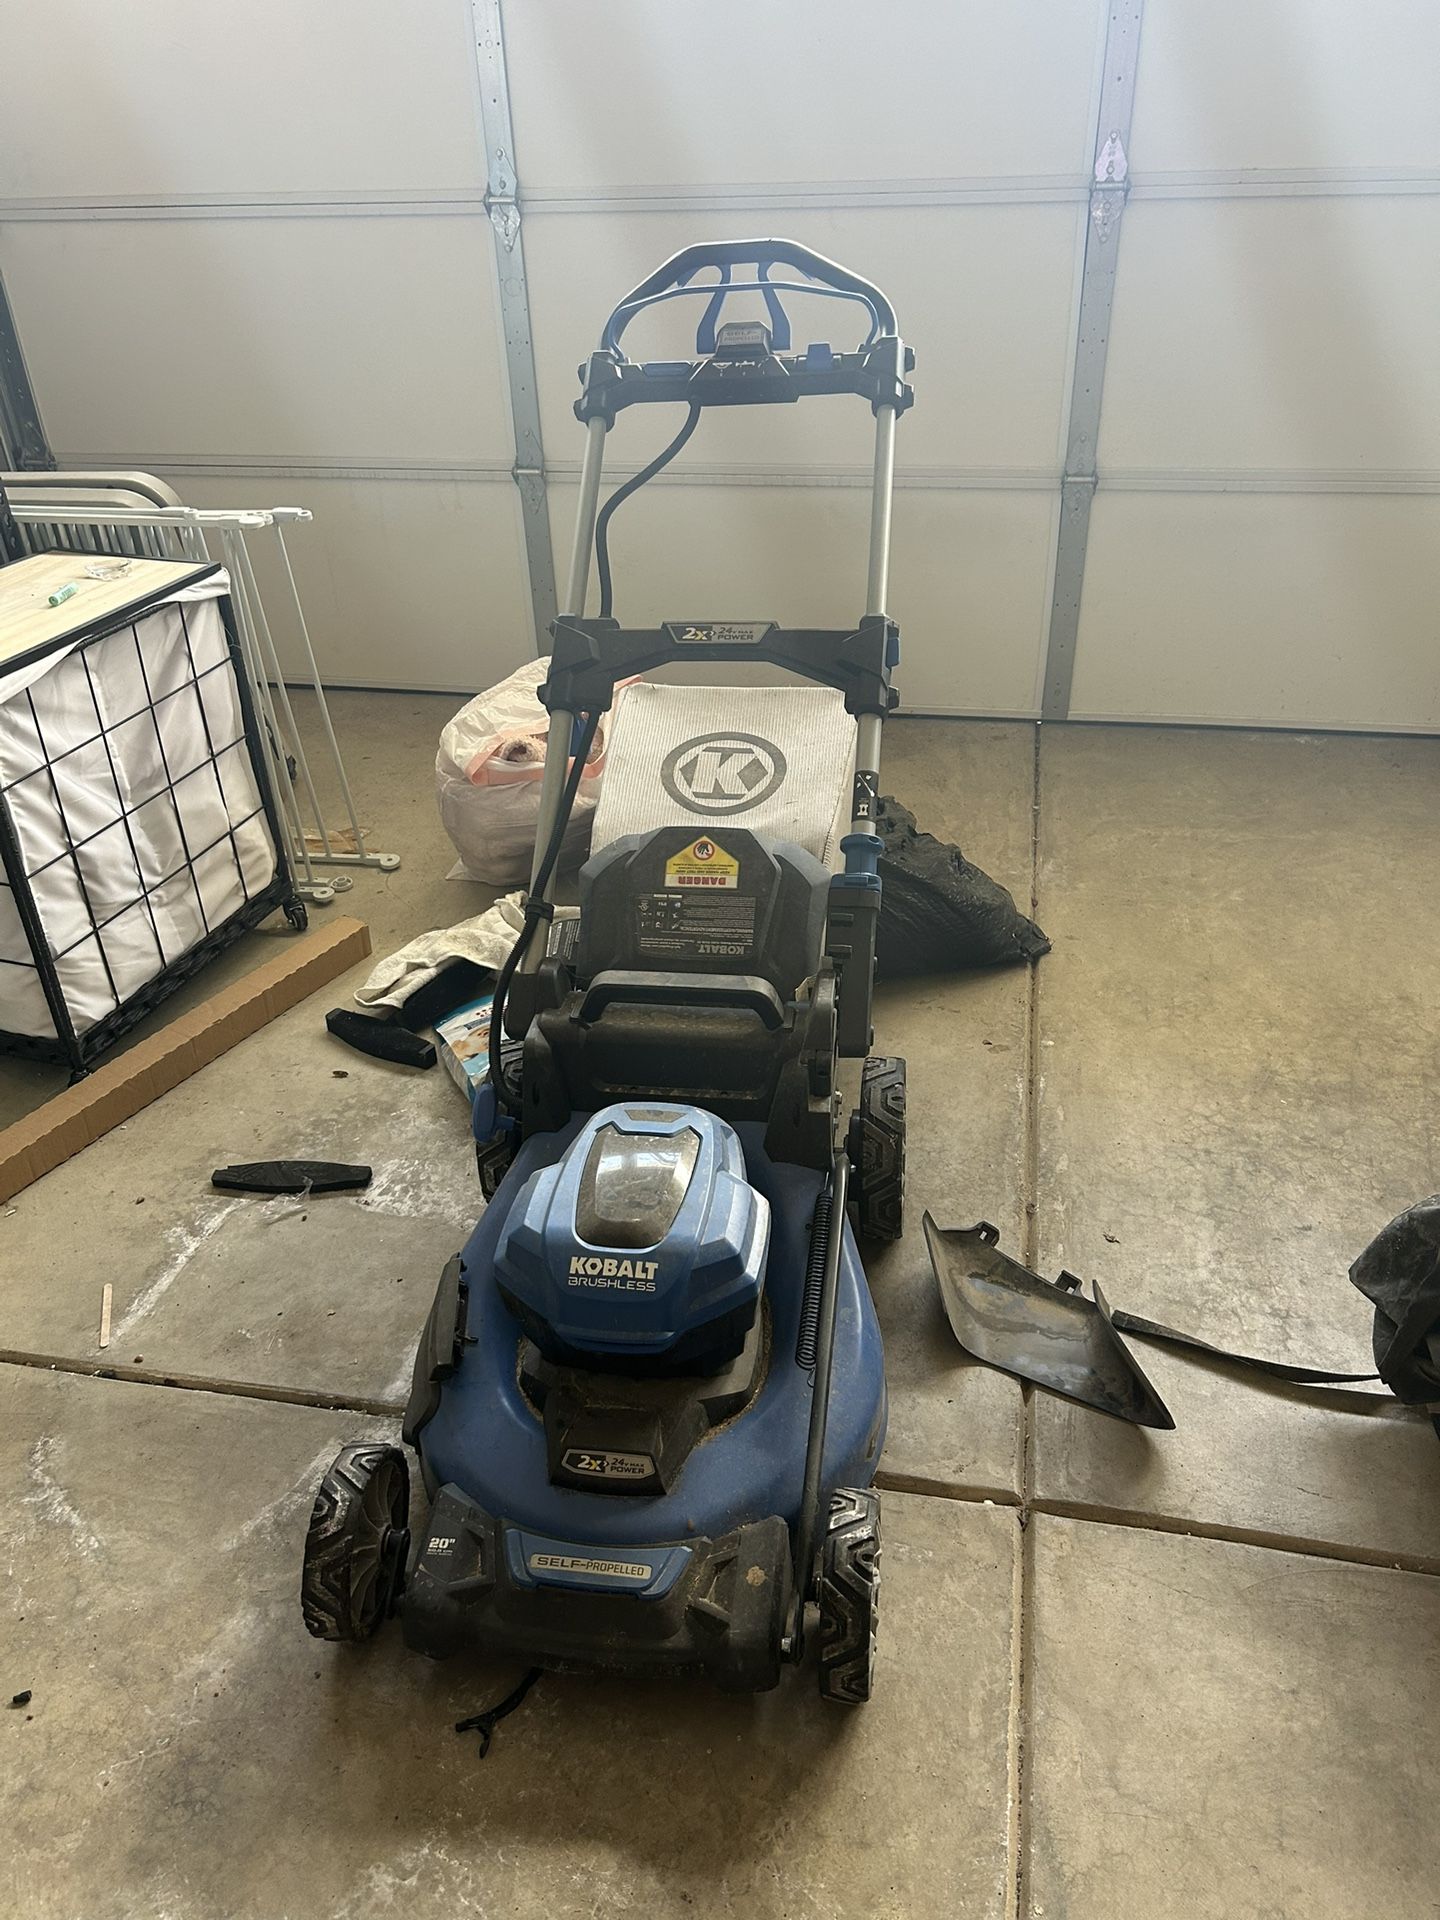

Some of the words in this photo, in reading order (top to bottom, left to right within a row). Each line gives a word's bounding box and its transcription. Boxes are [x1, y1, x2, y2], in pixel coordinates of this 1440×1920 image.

[678, 876, 726, 886] DANGER
[698, 944, 745, 955] KOBALT
[569, 1256, 659, 1280] KOBALT
[568, 1276, 656, 1292] BRUSHLESS
[610, 1466, 645, 1475] POWER
[429, 1537, 456, 1549] 20"
[537, 1556, 645, 1576] SELF-PROPELLED
